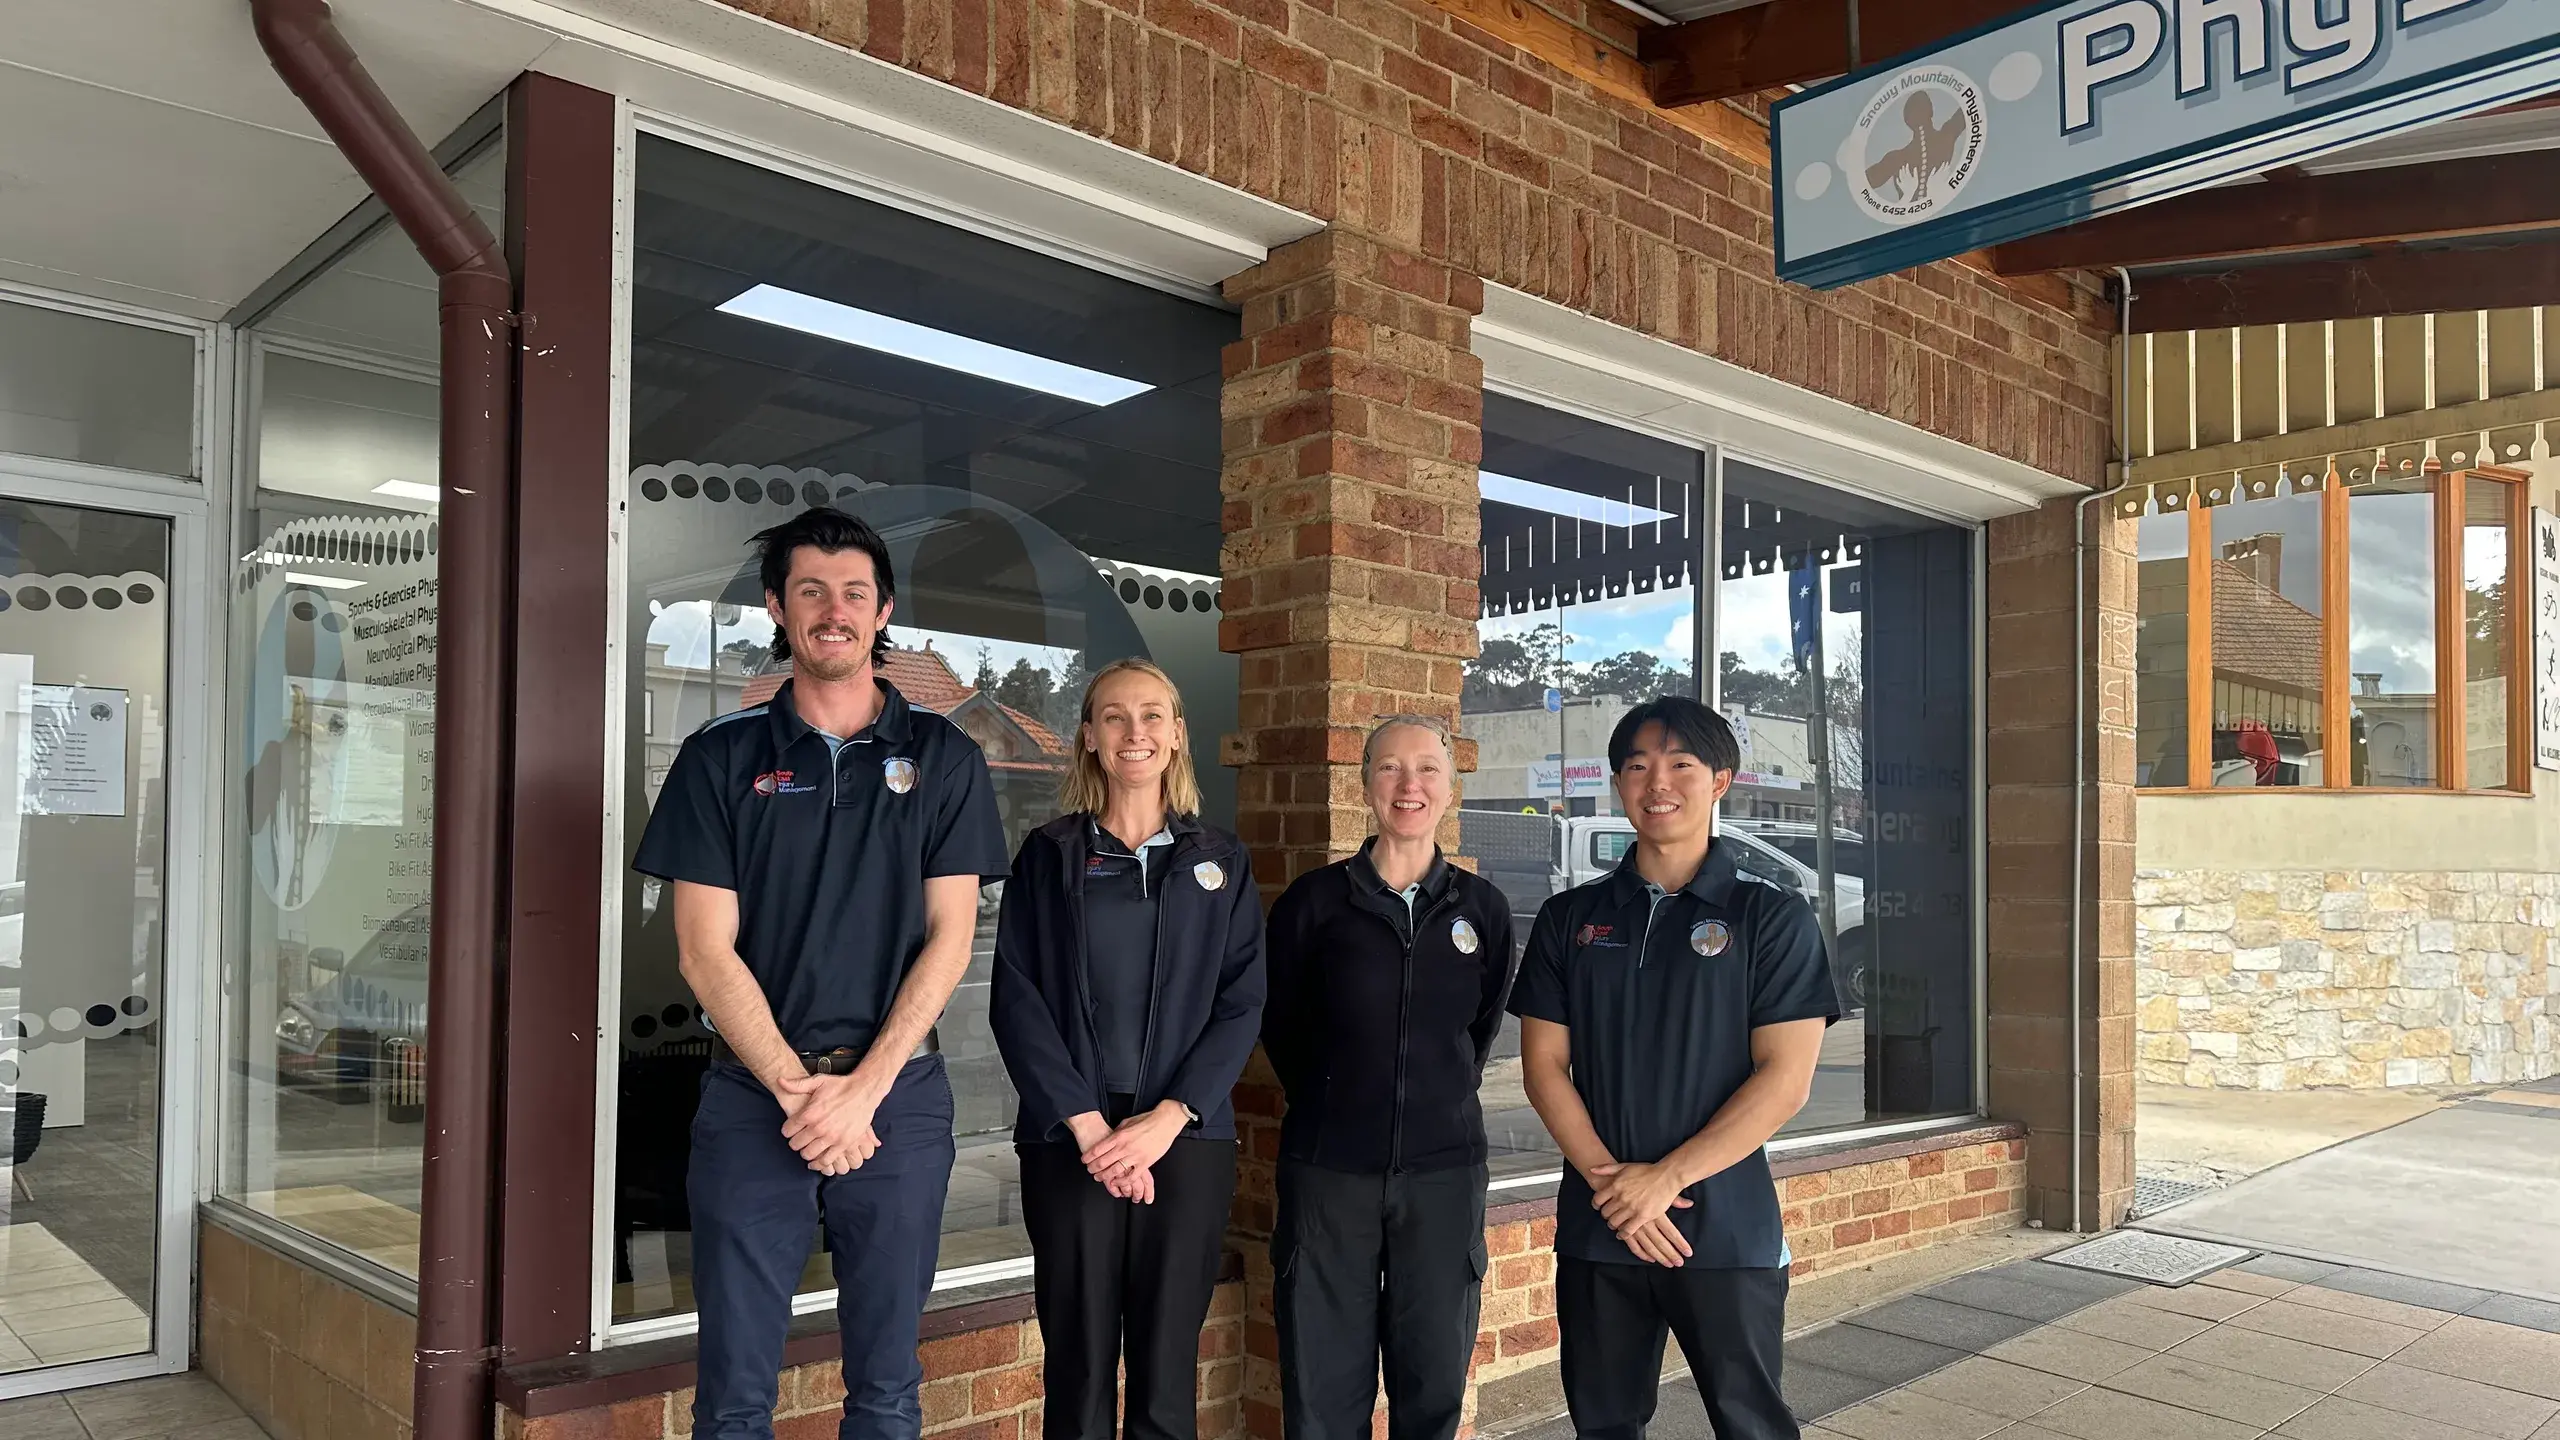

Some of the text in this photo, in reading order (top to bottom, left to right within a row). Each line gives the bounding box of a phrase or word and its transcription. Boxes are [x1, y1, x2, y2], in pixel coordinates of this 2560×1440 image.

[1860, 71, 1982, 189] Snowy Mountains Physiotherapy
[1861, 188, 1934, 215] Phone 6452 4203
[348, 597, 373, 620] Sports
[374, 593, 381, 609] &
[382, 584, 416, 608] Exercise
[353, 608, 416, 642] Musculoskeletal
[366, 640, 415, 665] Neurological
[364, 668, 415, 691] Manipulative
[363, 692, 414, 717] Occupational
[1863, 755, 1963, 791] ountains
[778, 785, 817, 794] Management
[394, 832, 407, 850] Ski
[409, 832, 420, 849] Fit
[388, 860, 406, 877] Bike
[408, 860, 420, 877] Fit
[386, 888, 418, 909] Running
[362, 914, 419, 935] Biomechanical
[379, 942, 419, 962] Vestibular
